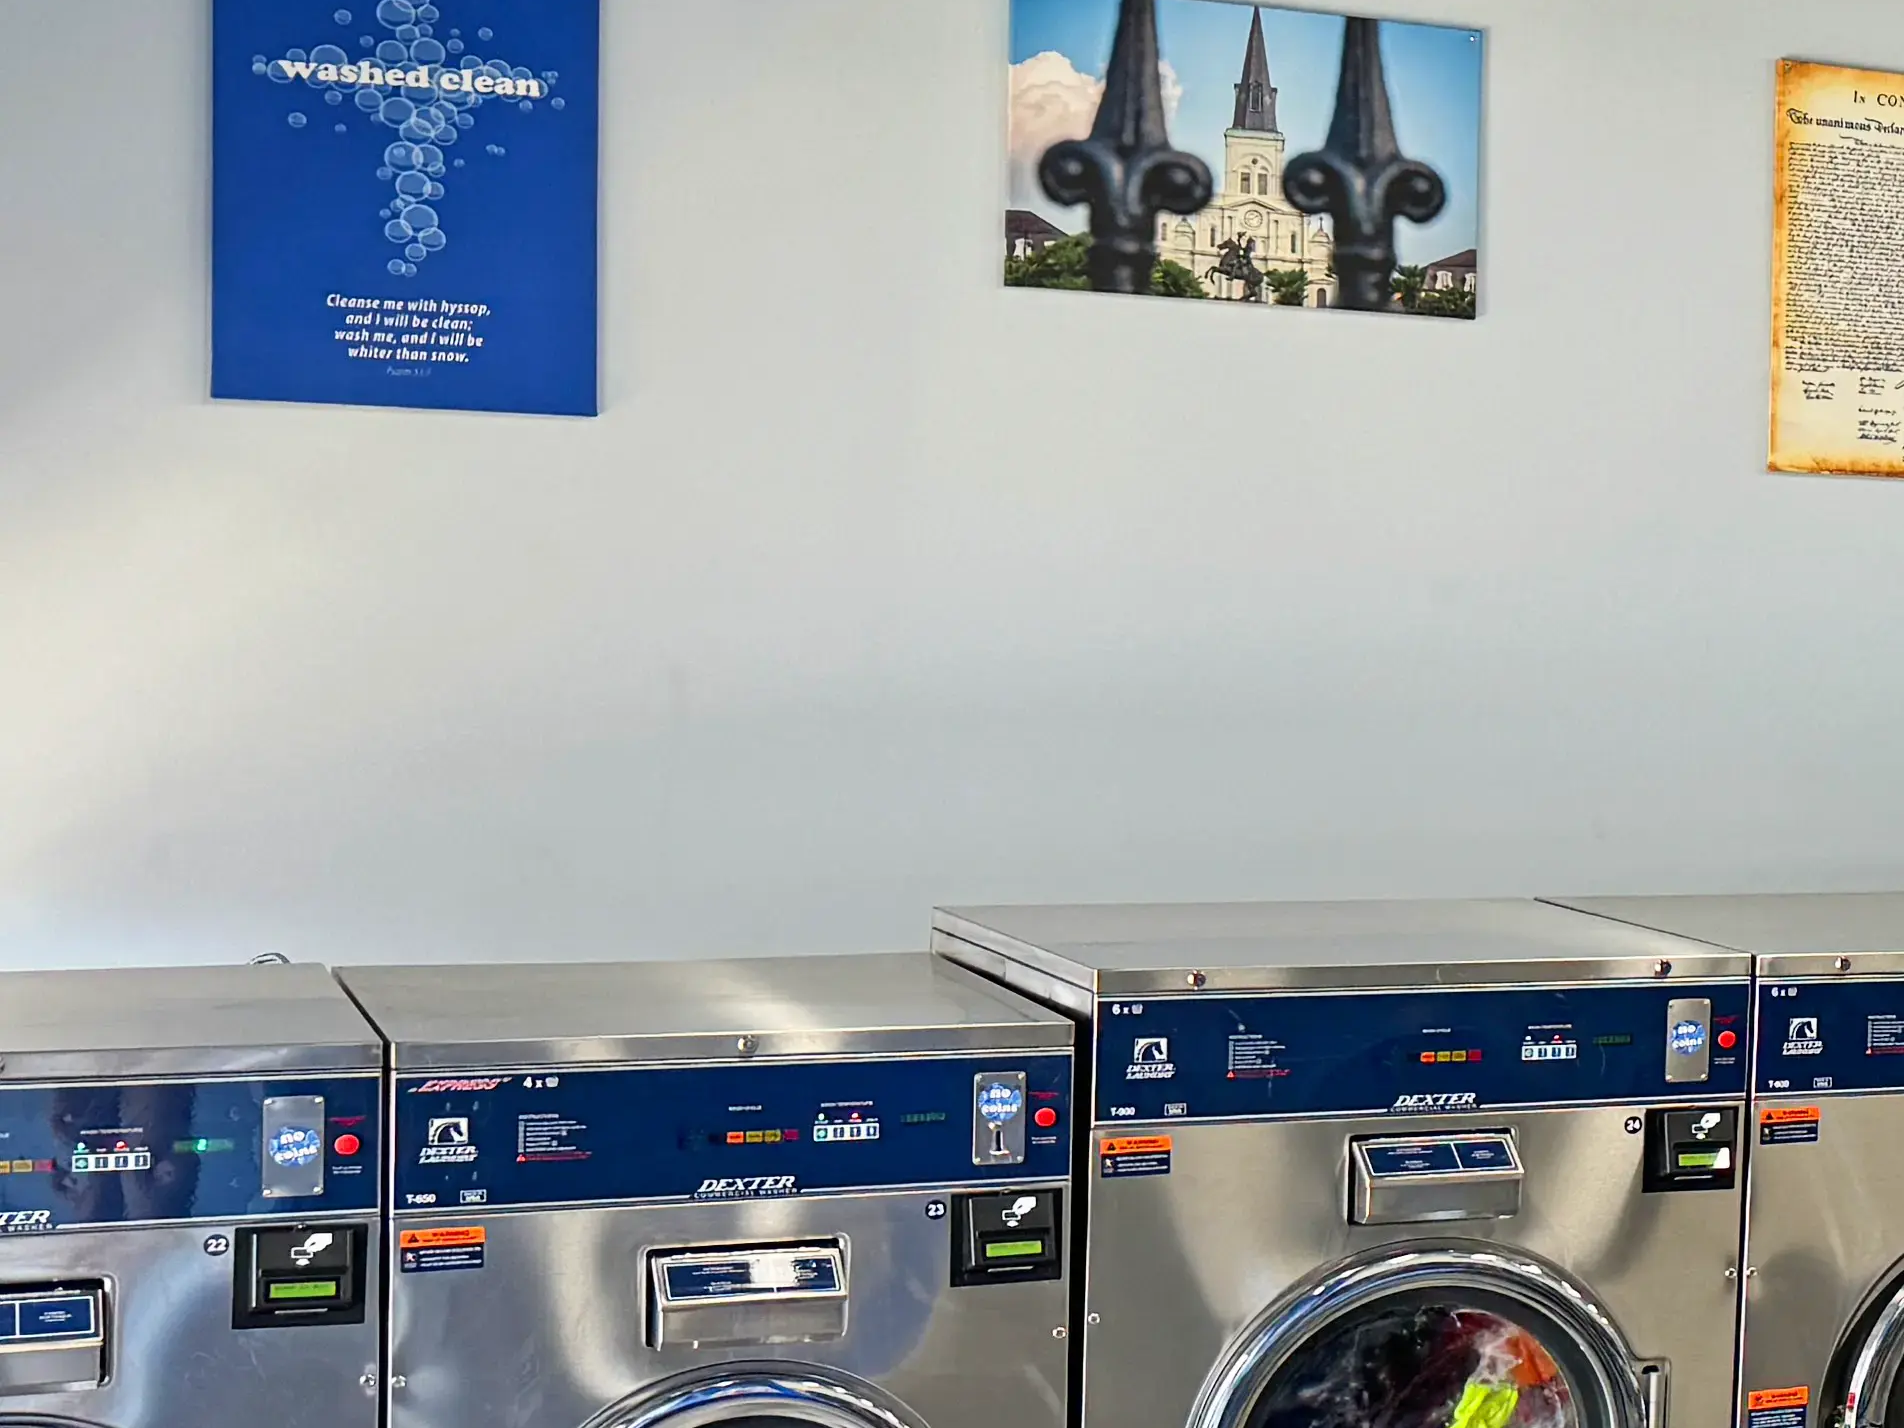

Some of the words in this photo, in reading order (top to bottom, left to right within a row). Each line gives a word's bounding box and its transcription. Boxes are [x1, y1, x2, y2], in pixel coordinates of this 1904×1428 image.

[278, 59, 428, 89] washed
[440, 69, 541, 98] clean
[1816, 118, 1871, 132] unanimous
[326, 294, 380, 309] Cleanse
[383, 299, 403, 310] me
[408, 299, 437, 312] with
[440, 300, 491, 316] hyssop,
[345, 313, 372, 324] and
[375, 314, 379, 324] I
[384, 314, 408, 327] will
[412, 316, 428, 328] be
[432, 317, 473, 331] clean;
[335, 329, 369, 341] wash
[373, 332, 397, 344] me,
[401, 332, 428, 344] and
[431, 334, 435, 344] I
[439, 334, 464, 346] will
[467, 334, 484, 347] be
[348, 345, 392, 360] whiter
[396, 347, 427, 361] than
[431, 351, 469, 363] snow.
[1112, 1004, 1120, 1015] 6
[523, 1077, 532, 1088] 4
[990, 1089, 1011, 1099] no
[1395, 1093, 1476, 1107] DEXTER
[984, 1103, 1017, 1113] coins
[1627, 1120, 1640, 1131] 24
[280, 1131, 305, 1144] no
[698, 1176, 796, 1192] DEXTER
[928, 1204, 945, 1216] 23
[207, 1239, 227, 1252] 22
